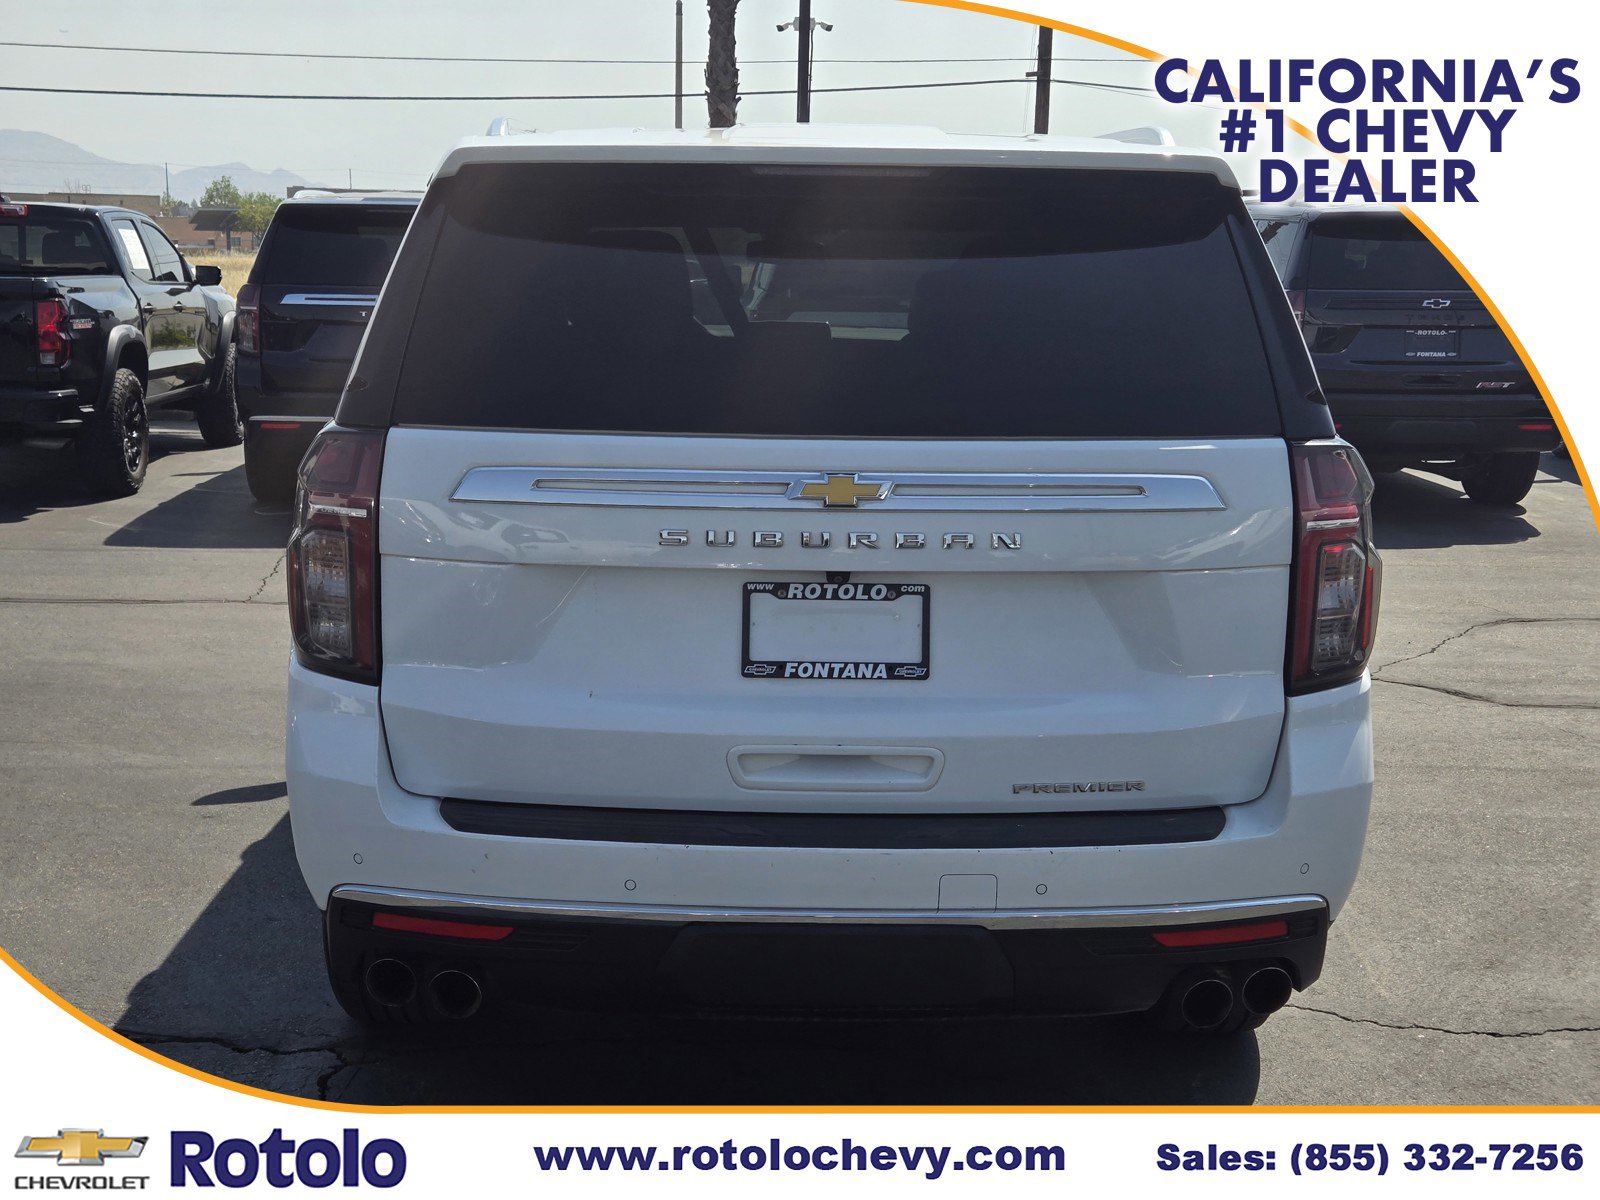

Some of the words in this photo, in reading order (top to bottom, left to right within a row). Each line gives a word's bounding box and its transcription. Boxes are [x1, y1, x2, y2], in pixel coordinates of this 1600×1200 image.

[658, 528, 1022, 549] SUBURBAN
[787, 583, 888, 600] ROTOLO
[784, 662, 888, 679] FONTANA
[1012, 780, 1146, 794] PREMIER
